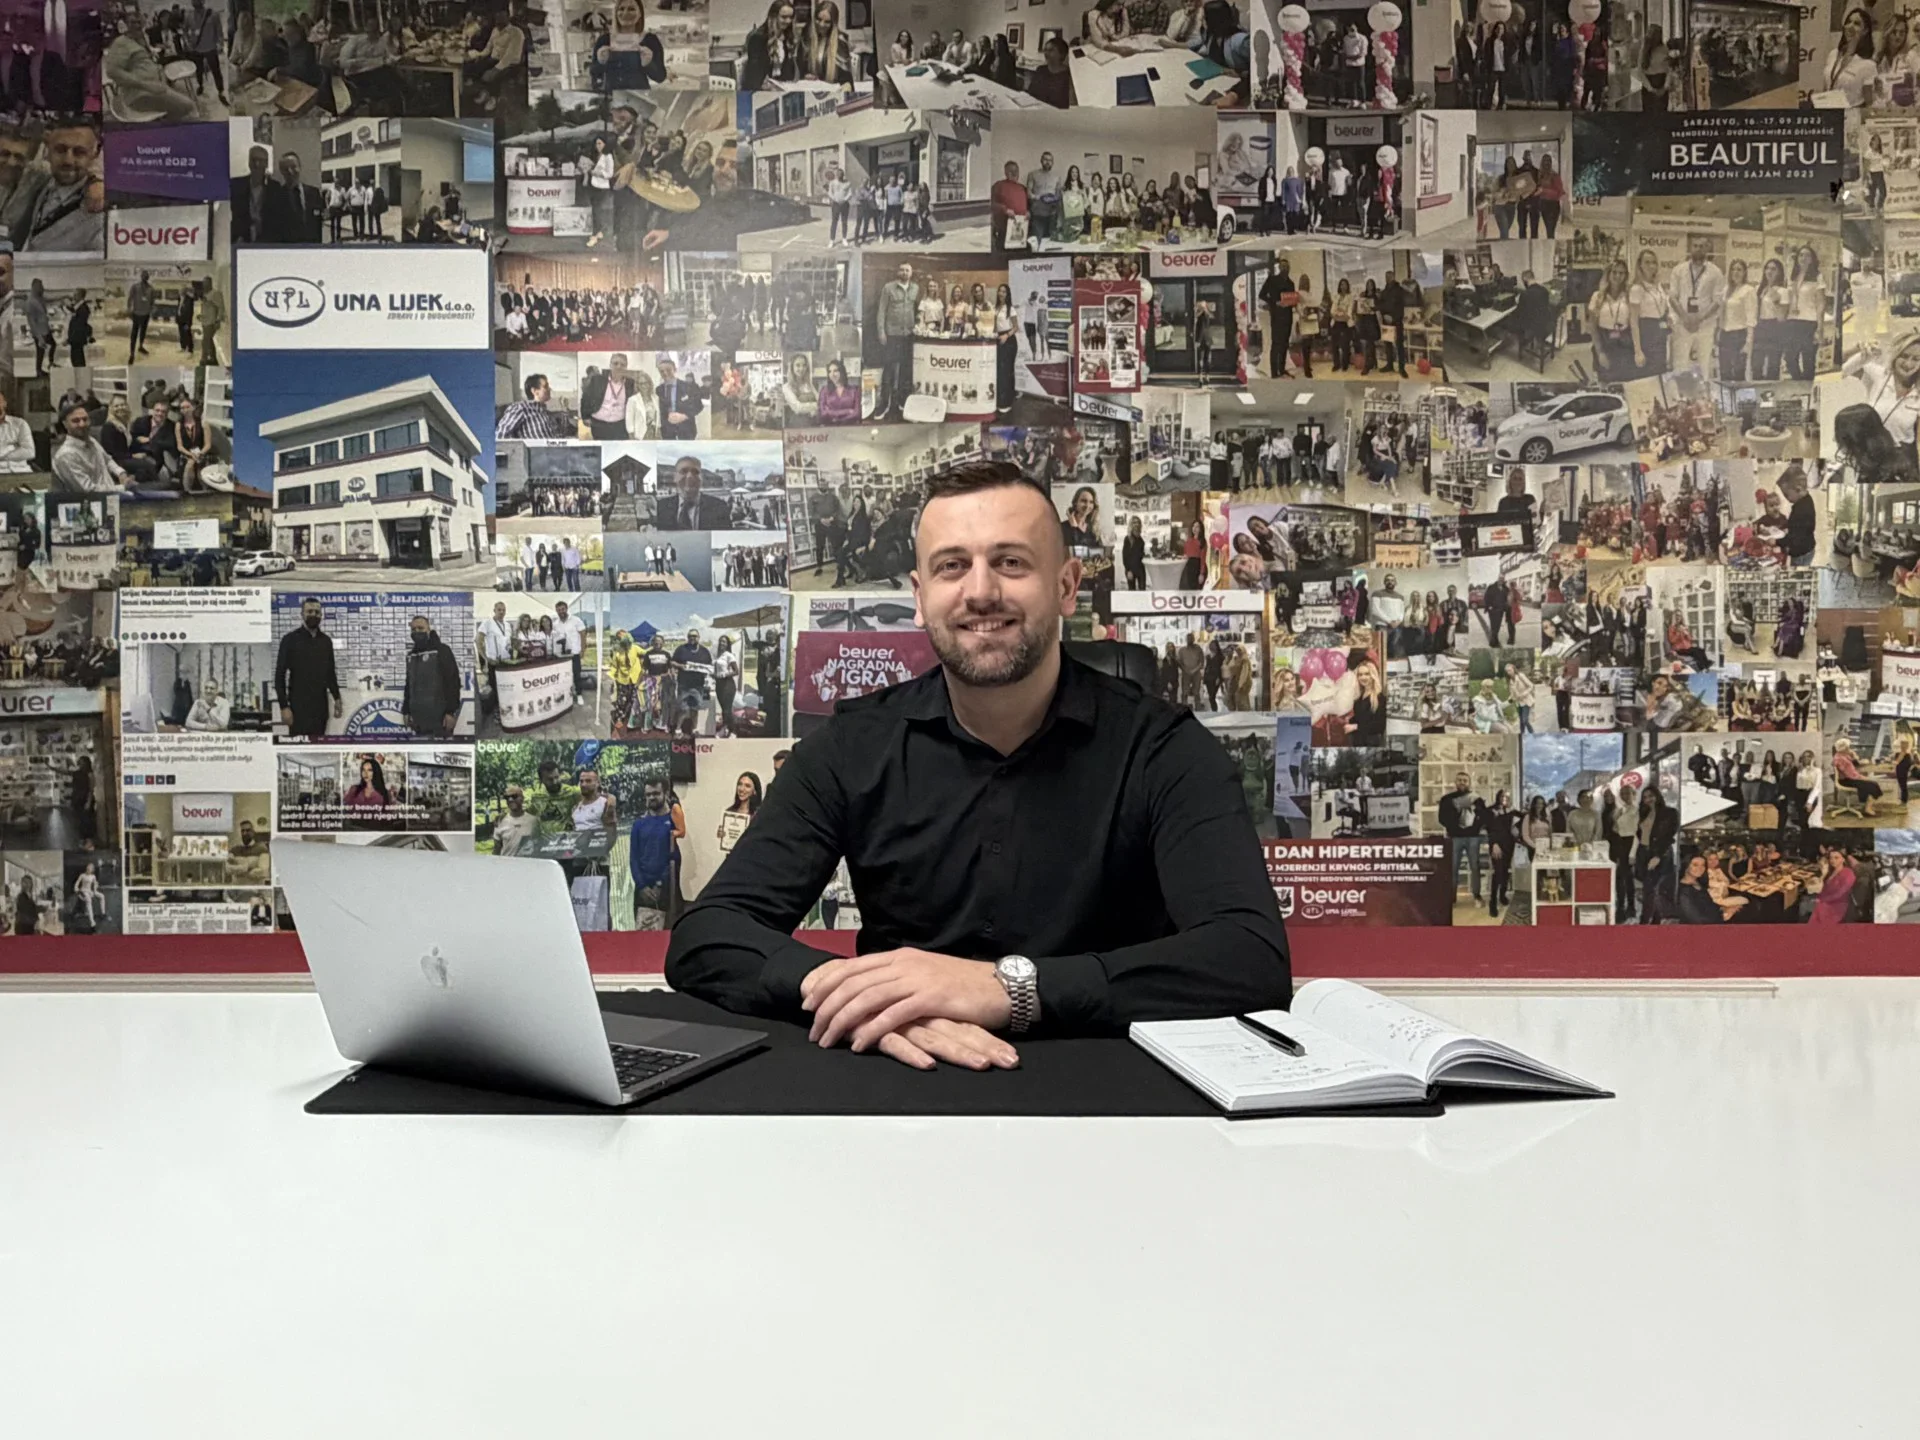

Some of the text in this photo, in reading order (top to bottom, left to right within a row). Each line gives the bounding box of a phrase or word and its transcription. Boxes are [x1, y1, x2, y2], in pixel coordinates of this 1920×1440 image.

[1333, 125, 1376, 137] beurer
[1670, 142, 1837, 166] BEAUTIFUL
[165, 158, 197, 166] 2023
[1743, 170, 1781, 178] SAJAM
[1786, 170, 1814, 178] 2023
[114, 222, 200, 246] beurer
[1161, 251, 1216, 268] beurer
[1022, 263, 1054, 272] beurer
[334, 294, 381, 311] UNA
[389, 294, 443, 311] LIJEK
[930, 353, 972, 369] beurer
[1077, 395, 1119, 419] beurer
[1559, 427, 1590, 439] beurer
[1150, 591, 1226, 610] beurer
[838, 643, 896, 660] beurer
[827, 658, 906, 673] NAGRADNA
[521, 673, 561, 690] beurer
[840, 669, 890, 687] IGRA
[477, 741, 521, 753] beurer
[672, 742, 715, 754] beurer
[433, 752, 468, 767] beurer
[182, 804, 223, 818] beurer
[1274, 845, 1315, 859] DAN
[1318, 845, 1444, 859] HIPERTENZIJE
[1275, 863, 1326, 872] MJERENJE
[1328, 863, 1372, 872] KRVNOG
[1373, 863, 1420, 872] PRITISKA
[1301, 885, 1367, 904] beurer
